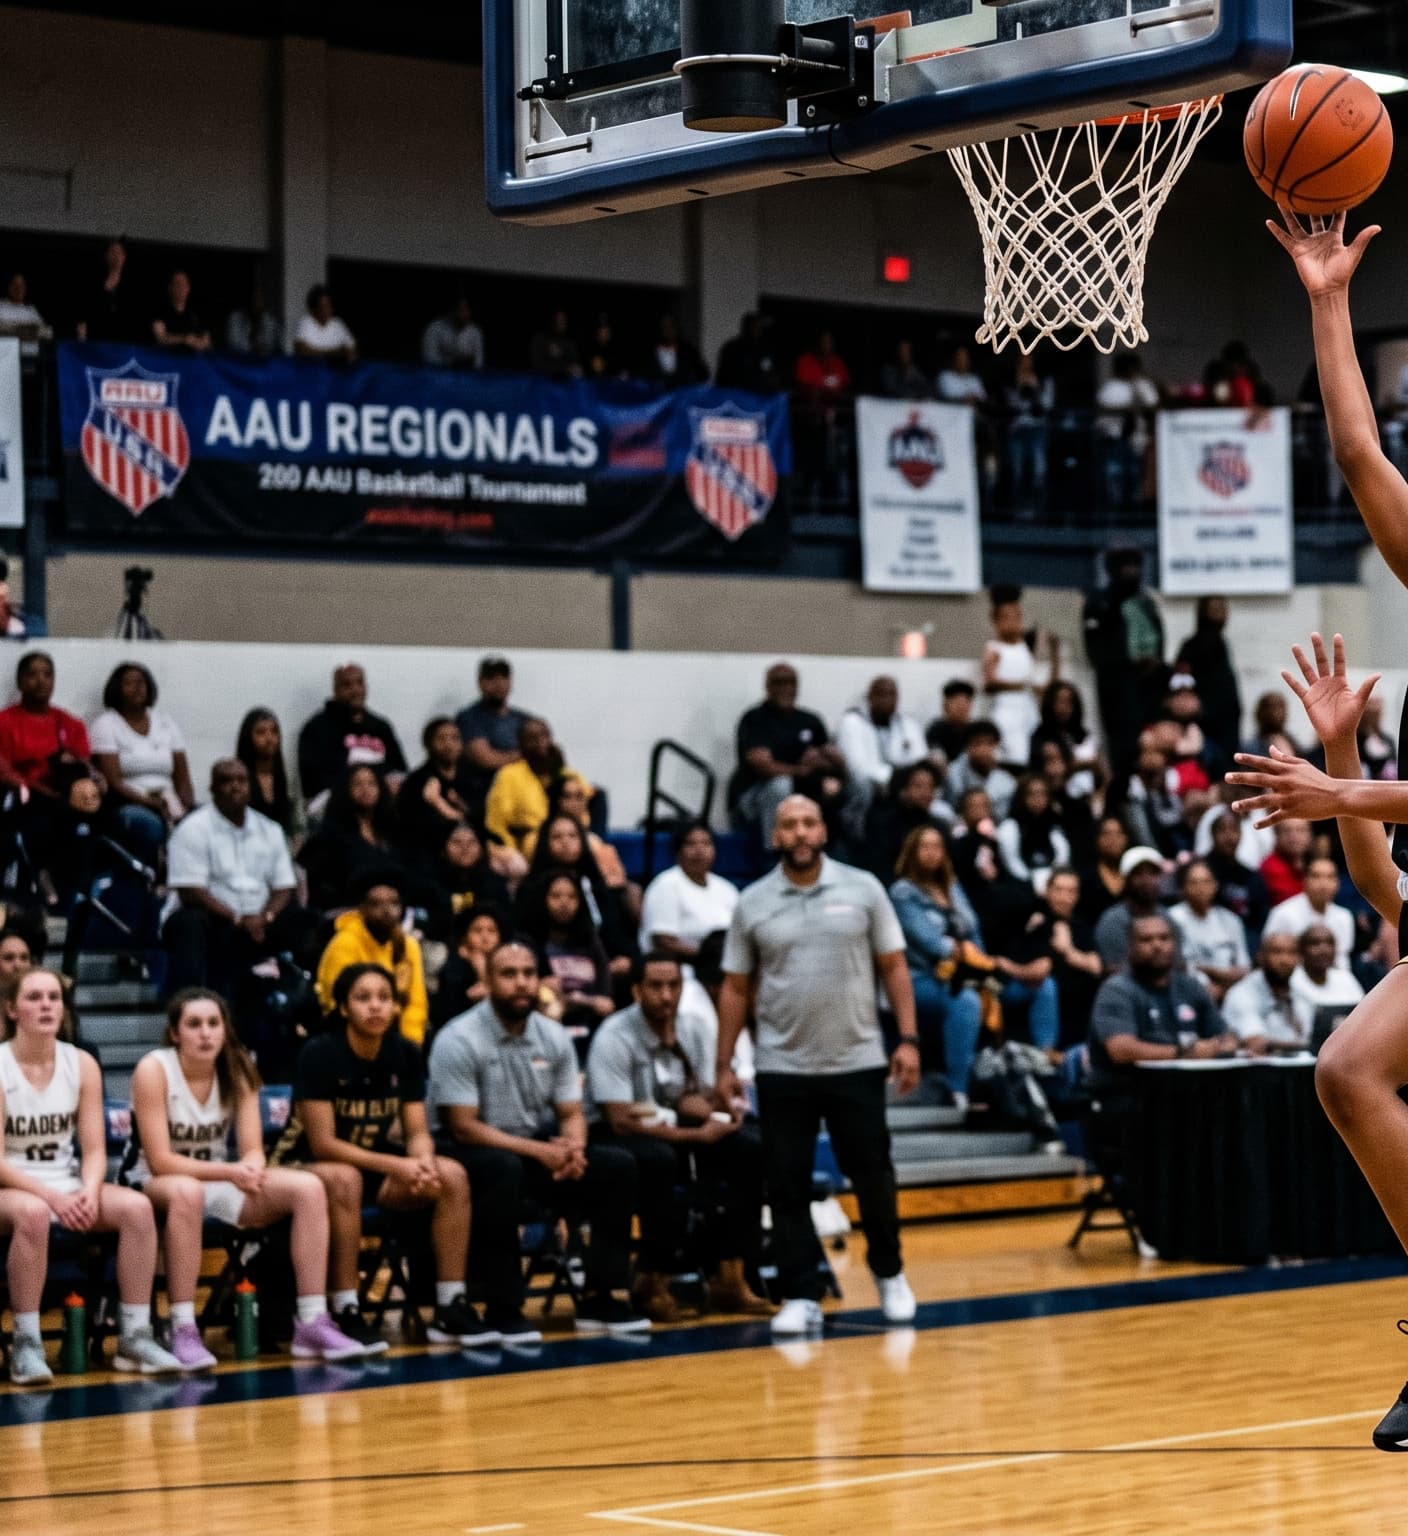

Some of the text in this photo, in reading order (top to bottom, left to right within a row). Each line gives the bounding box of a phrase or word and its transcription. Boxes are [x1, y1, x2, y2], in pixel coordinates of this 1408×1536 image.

[205, 395, 313, 452] AAU
[326, 402, 600, 470] REGIONALS
[305, 466, 352, 494] AAU
[356, 469, 465, 499] Basketball
[468, 474, 587, 506] Tournament
